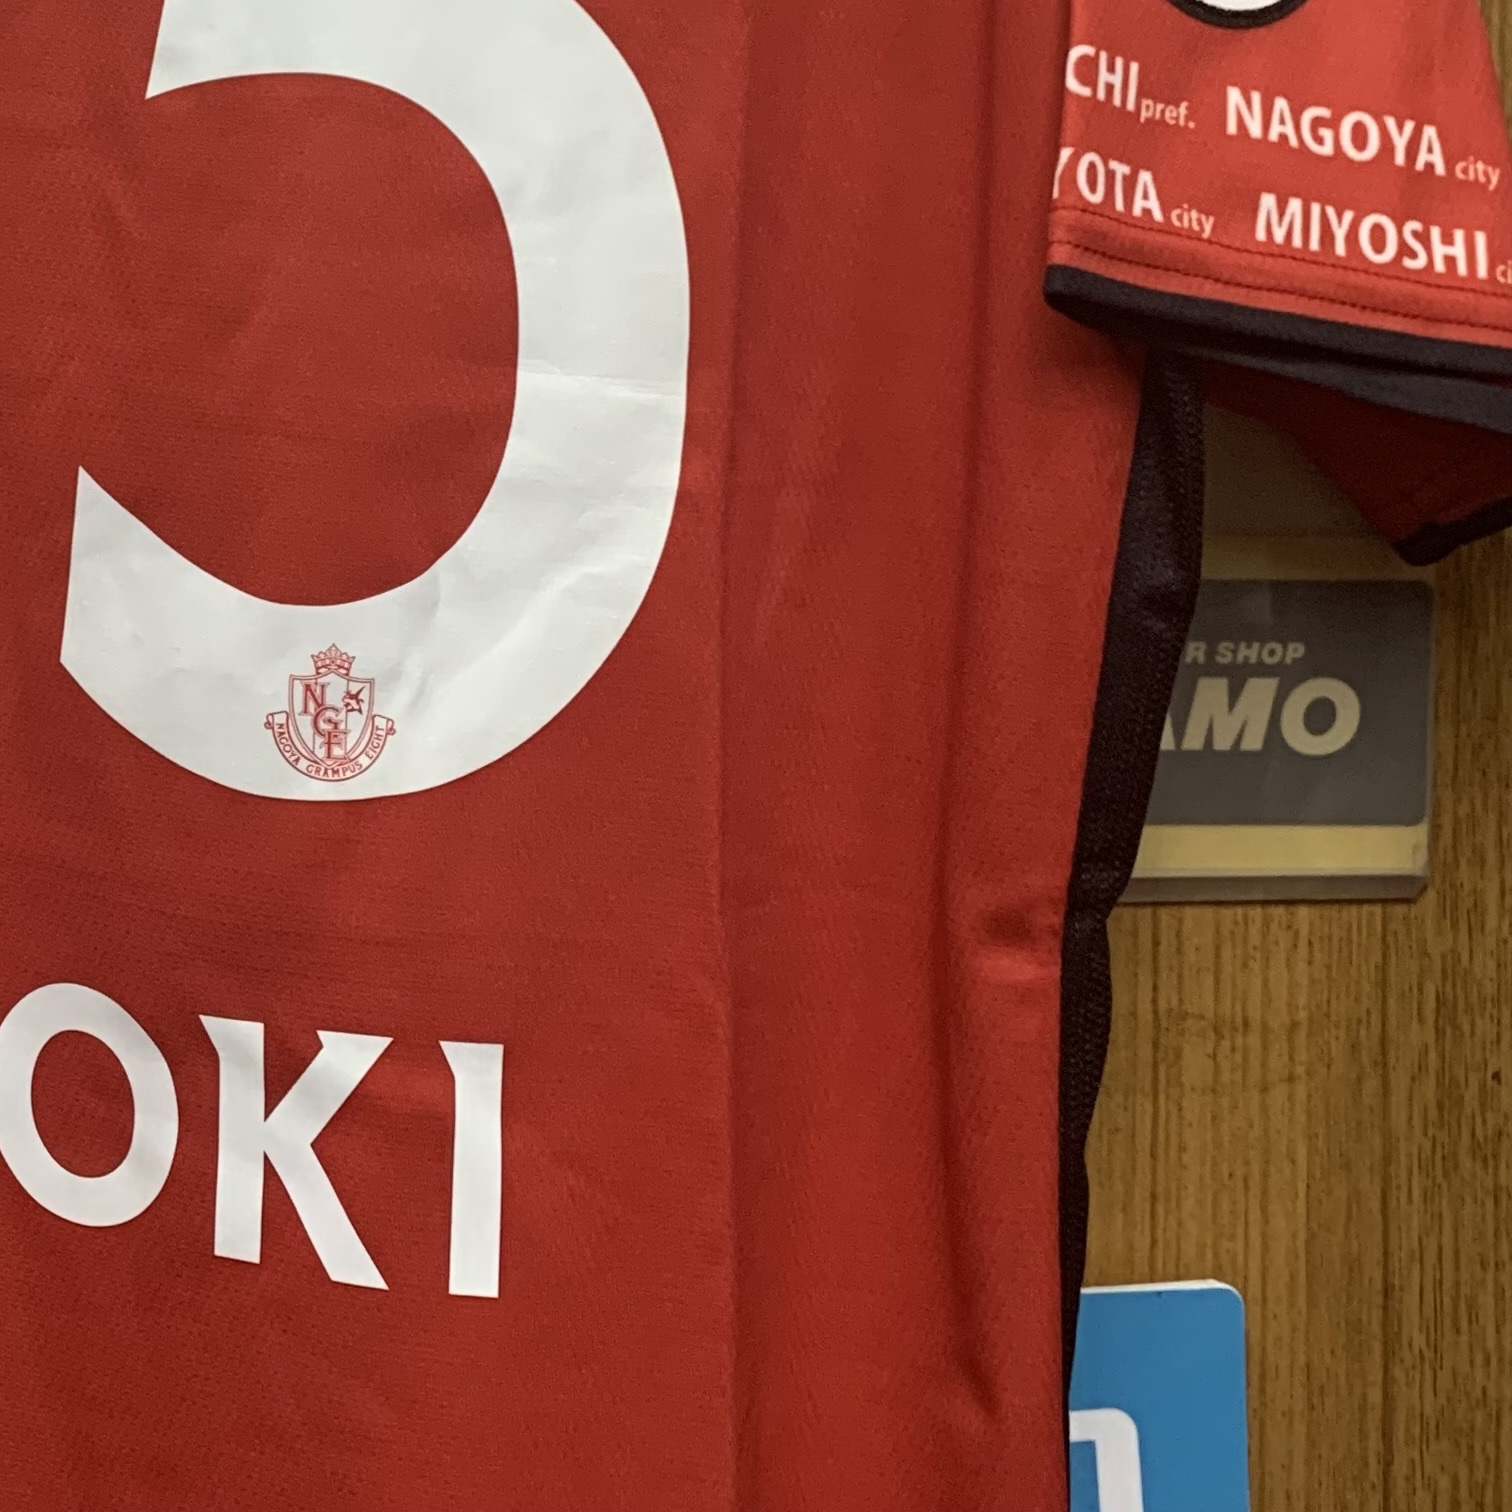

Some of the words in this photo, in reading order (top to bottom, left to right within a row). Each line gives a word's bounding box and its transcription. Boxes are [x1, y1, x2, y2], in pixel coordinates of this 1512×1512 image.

[1225, 85, 1447, 177] NAGOYA
[1454, 157, 1501, 191] city
[1170, 202, 1215, 239] city
[1254, 191, 1489, 281] MIYOSHI
[1215, 641, 1305, 665] SHOP
[275, 722, 301, 766] NAGOYA
[305, 760, 364, 779] GRAMPUS
[365, 724, 385, 760] EIGHT
